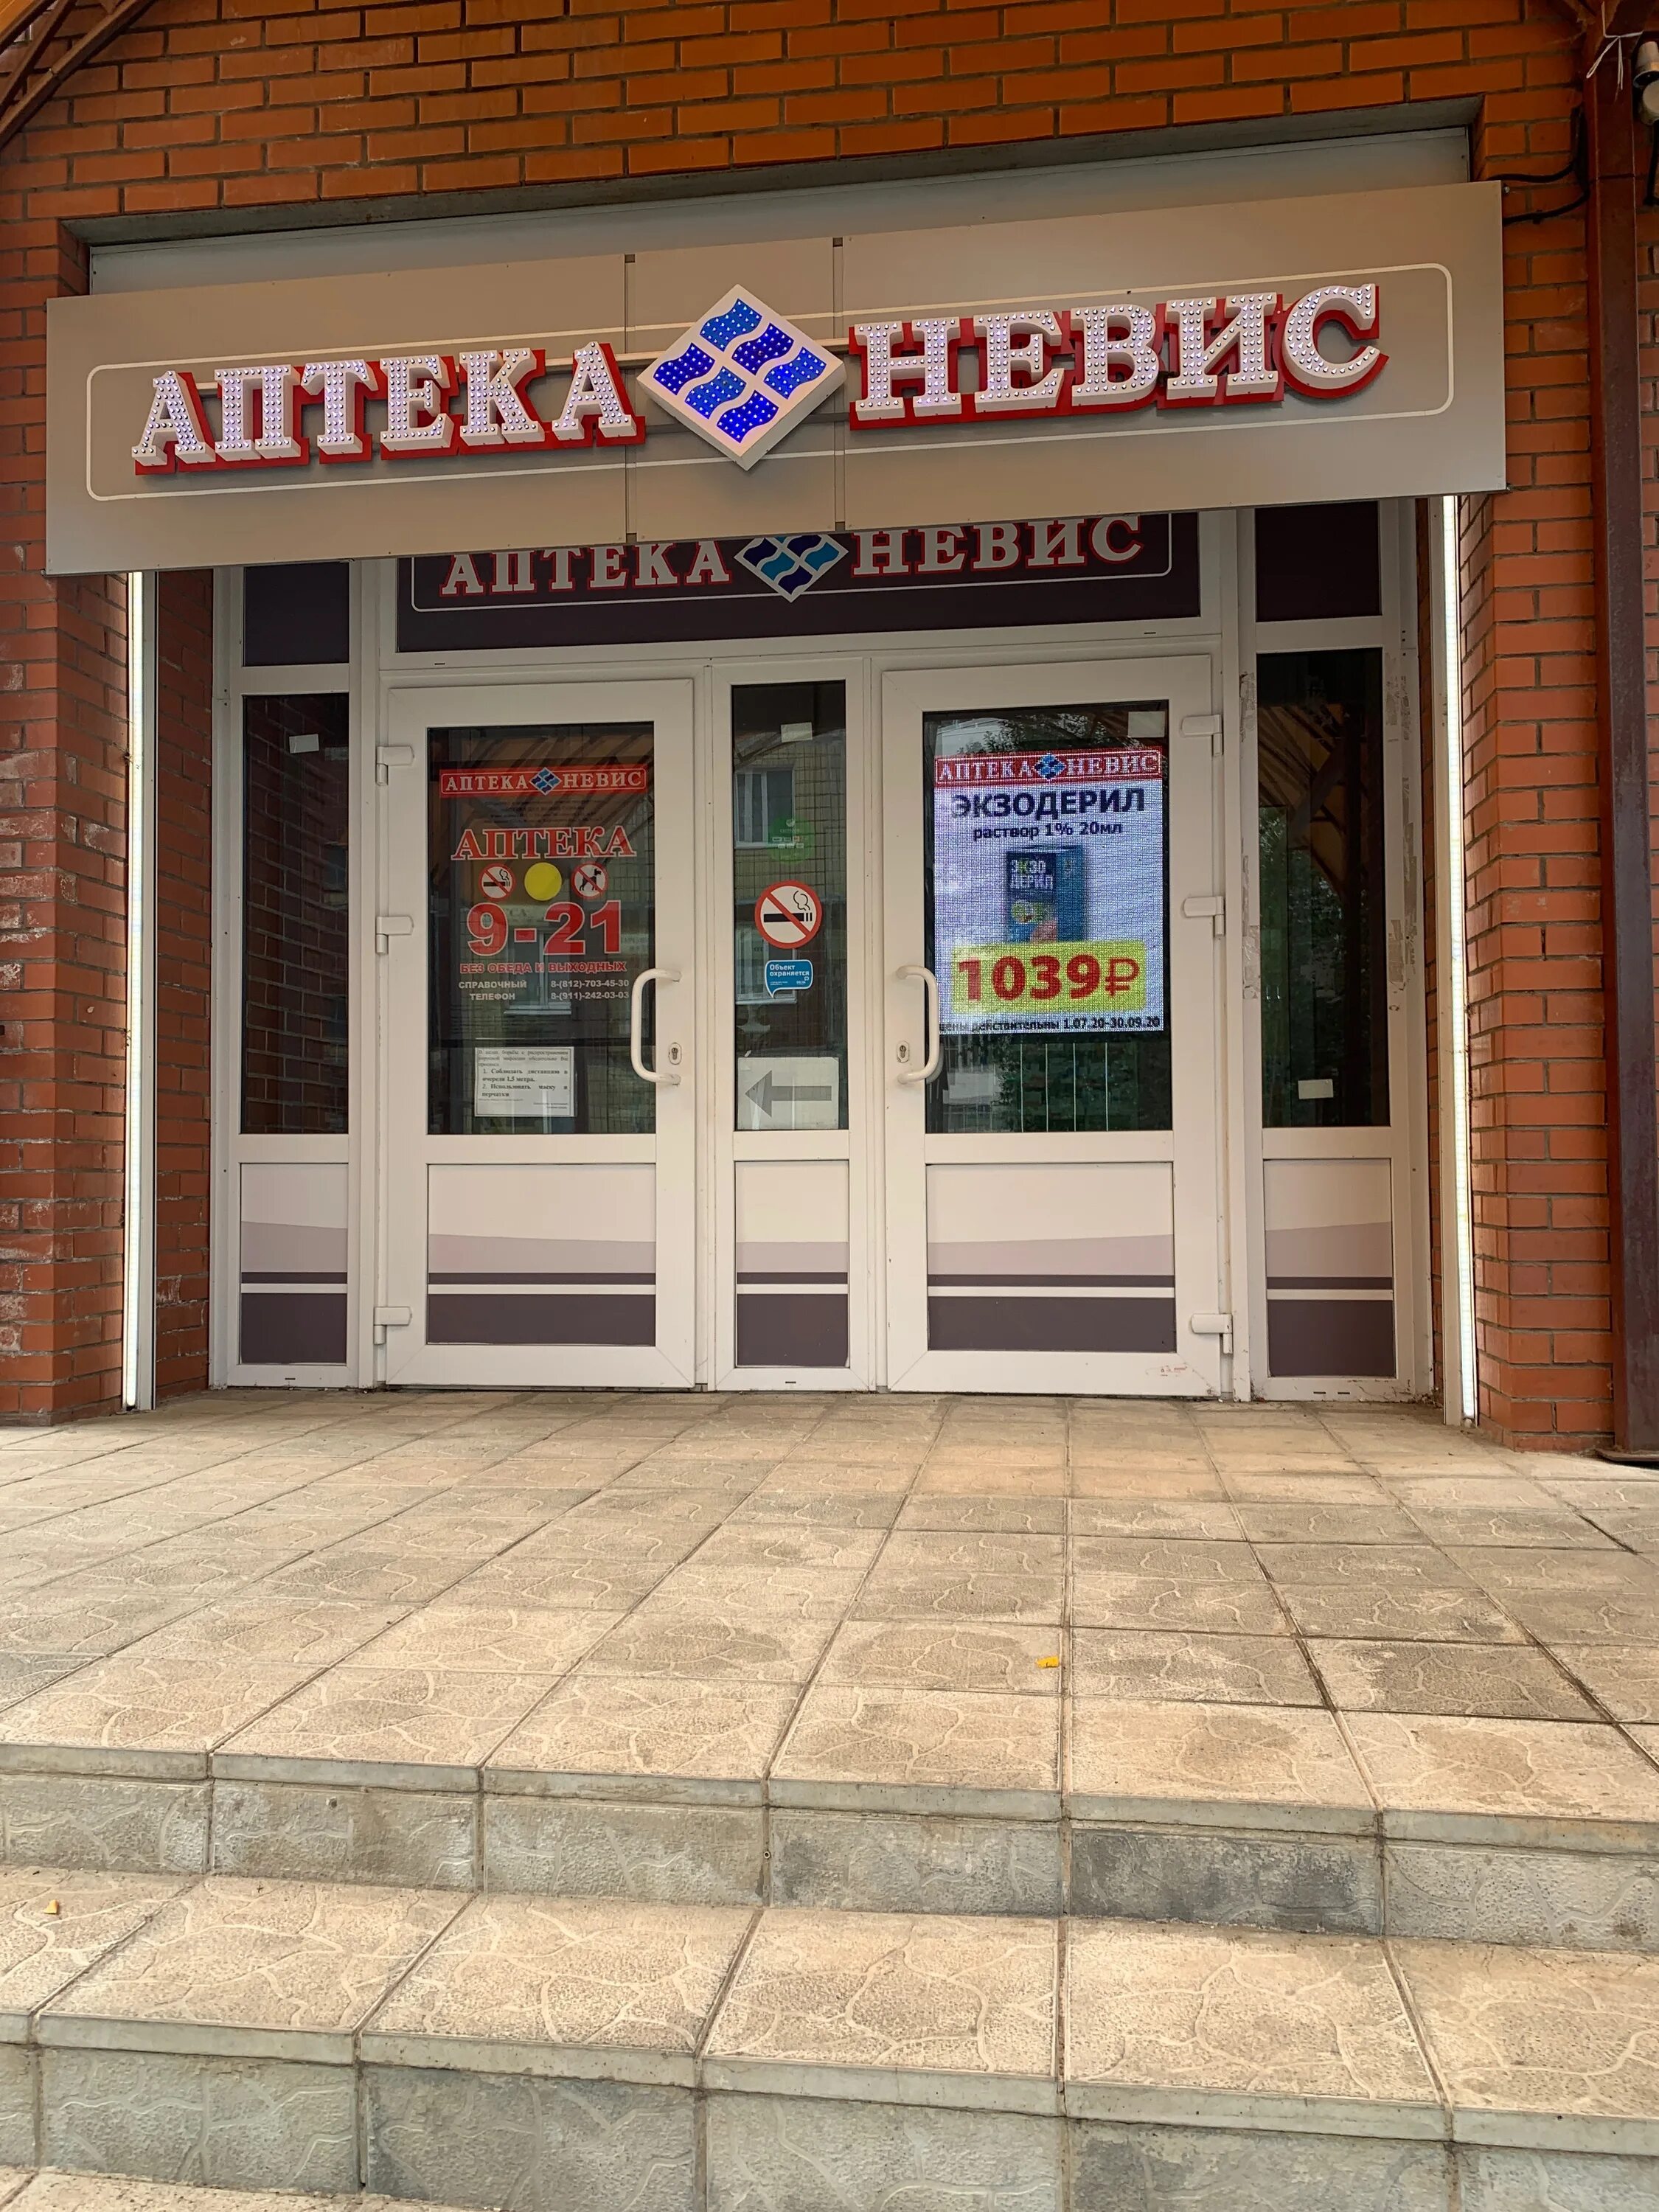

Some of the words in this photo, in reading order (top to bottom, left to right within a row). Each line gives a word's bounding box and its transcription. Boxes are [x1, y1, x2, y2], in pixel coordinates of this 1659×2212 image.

[132, 341, 646, 475] АПТЕКА
[849, 283, 1389, 430] НЕВИС
[440, 540, 731, 596] АПТЕКА
[852, 516, 1144, 577] НЕВИС
[939, 759, 1033, 780] АПТЕКА
[1066, 754, 1158, 776] НЕВИС
[445, 776, 529, 791] АПТЕКА
[563, 771, 642, 788] НЕВИС
[951, 788, 1144, 821] ЭКЗОДЕРИЛ
[973, 825, 1038, 841] раствор
[1045, 823, 1074, 837] 1%
[1079, 821, 1122, 835] 20мл
[451, 825, 637, 860] АПТЕКА
[467, 900, 622, 956] 9-21
[459, 963, 484, 974] БЕЗ
[487, 962, 532, 974] ОБЕДА
[535, 962, 545, 973] И
[548, 961, 627, 974] ВЫХОДНЫХ
[459, 980, 527, 990] СПРАВОЧНЫЙ
[551, 979, 630, 989] 8-(812)-703-45-30
[469, 992, 516, 1001] ТЕЛЕФОН
[551, 991, 630, 1001] 8-(911)-242-03-03
[972, 1020, 1060, 1032] действительны
